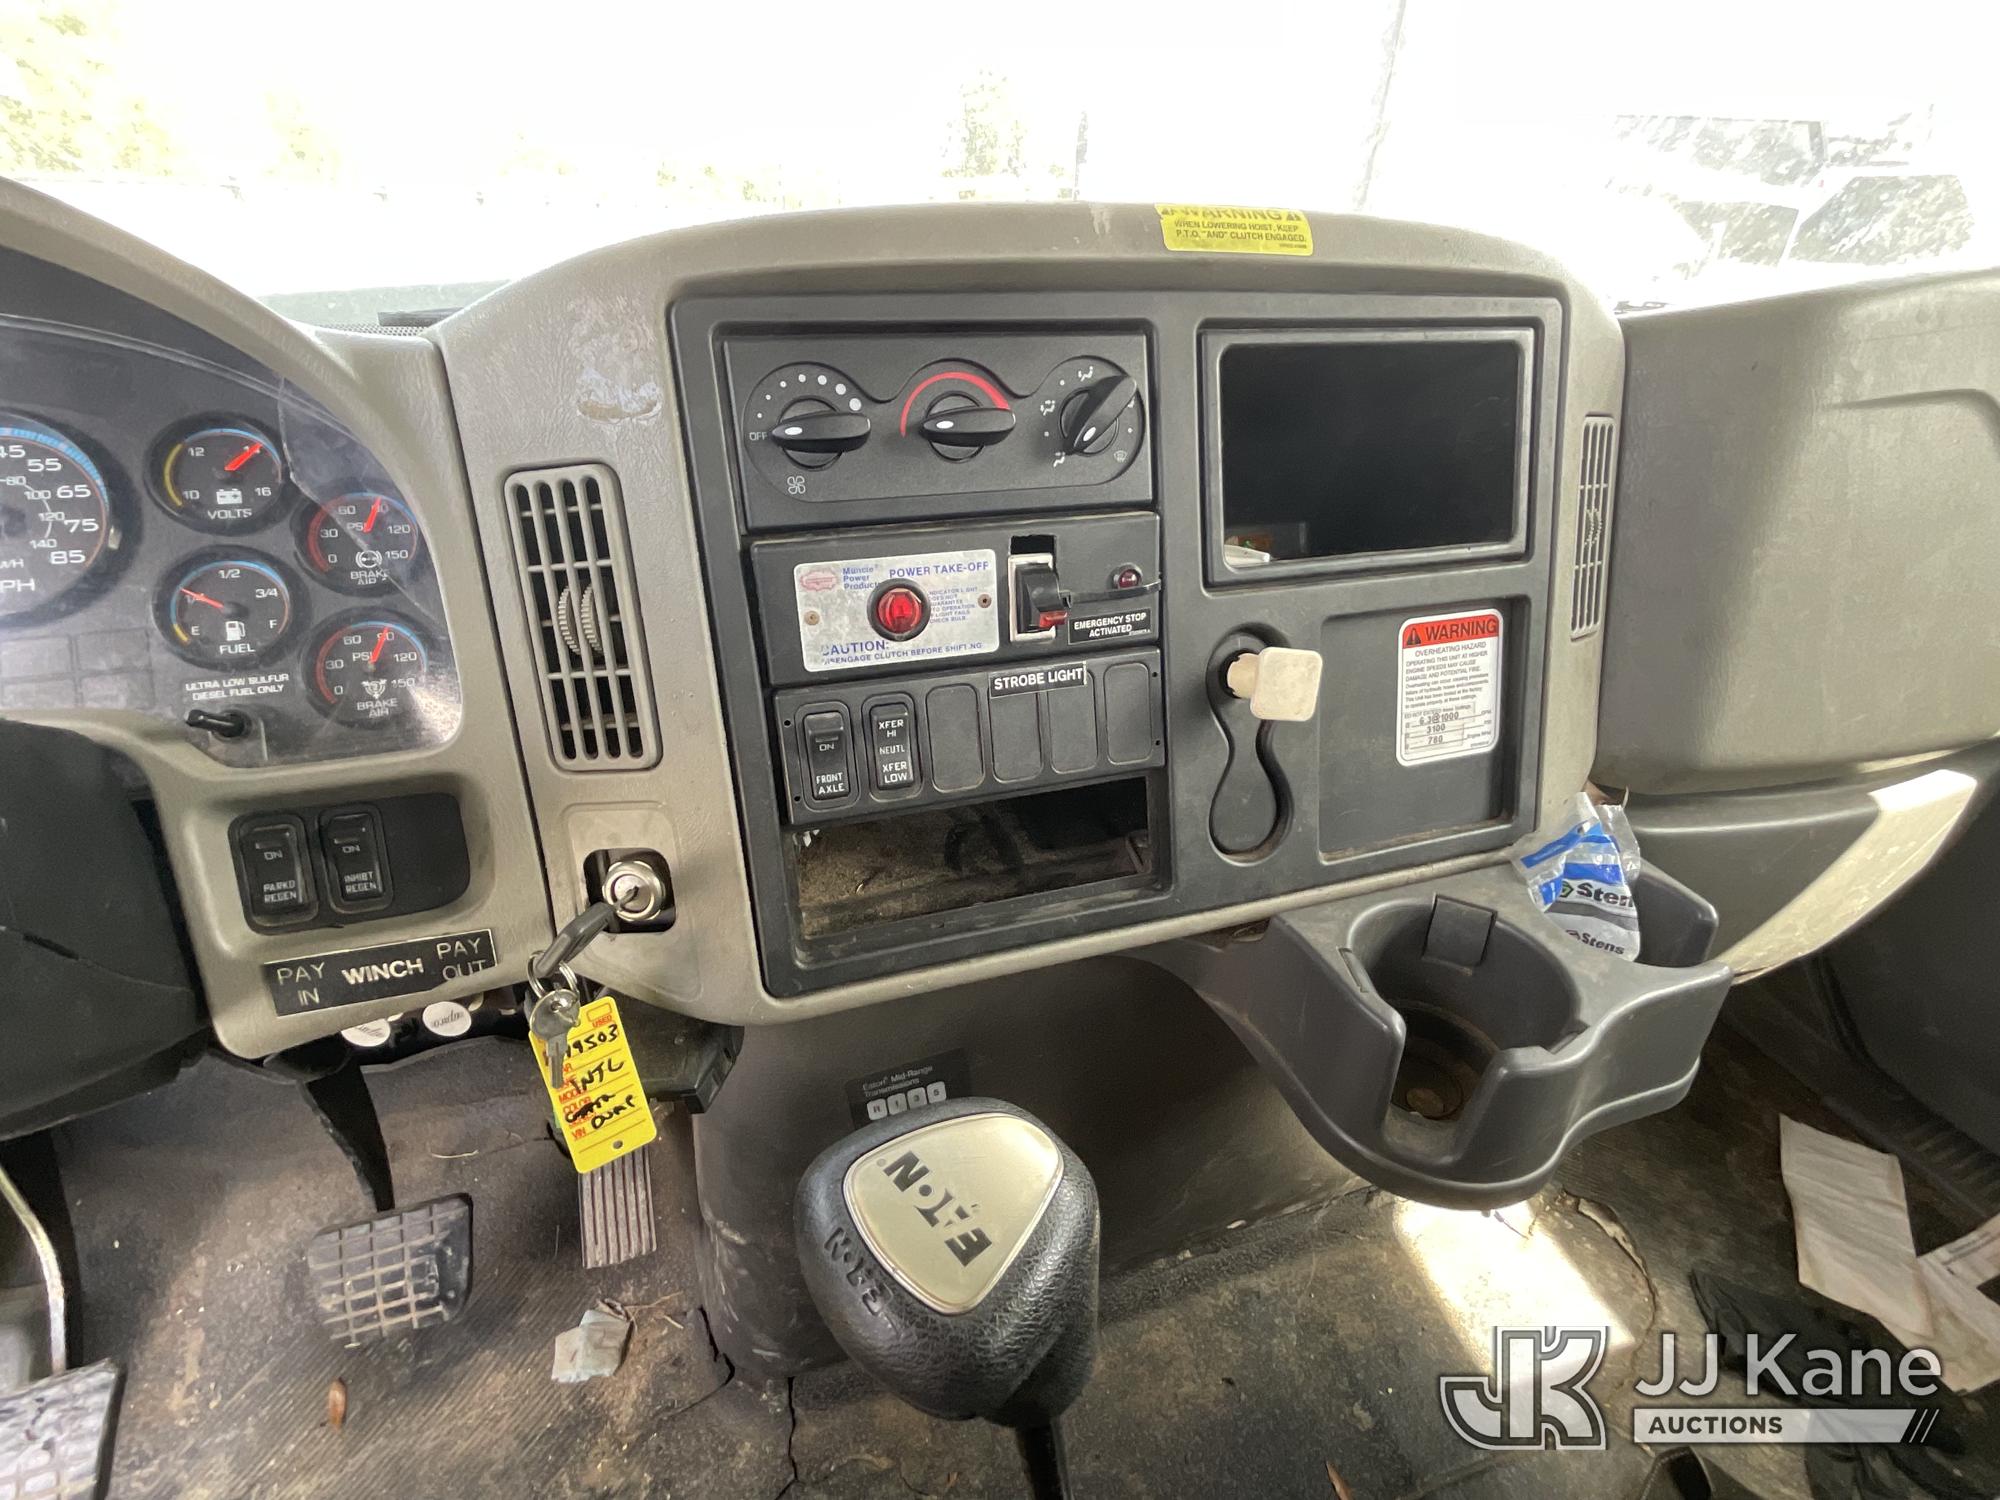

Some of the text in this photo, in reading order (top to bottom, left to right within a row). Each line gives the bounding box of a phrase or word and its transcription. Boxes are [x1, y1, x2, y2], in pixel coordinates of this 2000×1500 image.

[1174, 220, 1200, 228] WHEN
[1202, 222, 1247, 230] LOWERING
[1230, 232, 1264, 241] CLUTCH
[749, 431, 768, 441] OFF
[188, 446, 205, 457] 12
[27, 458, 62, 472] 55
[6, 476, 27, 486] 80
[24, 490, 52, 501] 100
[56, 484, 92, 499] 65
[183, 490, 200, 500] 10
[254, 486, 272, 497] 16
[38, 512, 65, 522] 120
[207, 508, 253, 520] VOLTS
[64, 518, 100, 534] 75
[387, 524, 411, 534] 120
[320, 528, 339, 538] 30
[30, 538, 58, 550] 140
[50, 550, 86, 565] 85
[328, 554, 338, 564] 0
[384, 550, 409, 560] 150
[218, 568, 241, 580] 1/2
[842, 566, 874, 575] Muncie
[889, 561, 989, 579] POWER TAKE-OFF
[843, 574, 870, 582] Power
[0, 578, 36, 592] PH
[255, 588, 279, 599] 3/4
[929, 588, 960, 596] NDICATOR
[269, 619, 278, 630] F
[1074, 612, 1147, 630] EMERGENCY STOP
[191, 626, 200, 636] E
[1088, 624, 1133, 638] ACTIVATED
[1425, 618, 1497, 641] WARNING
[343, 635, 362, 646] 60
[219, 643, 256, 655] FUEL
[874, 650, 909, 660] CLUTCH
[910, 646, 943, 656] BEFORE
[945, 642, 983, 653] SHIFTNG
[1414, 641, 1487, 658] OVERHEATING HAZARD
[394, 651, 418, 663] 120
[1406, 657, 1436, 667] OPERATING
[326, 658, 345, 670] 30
[185, 673, 290, 692] ULTRA LOW SULFUR
[391, 678, 416, 689] 150
[994, 668, 1083, 690] STROBE LIGHT
[192, 684, 285, 701] DIESEL FUEL ONLY
[334, 685, 344, 696] 0
[356, 698, 398, 711] BRAKE
[878, 718, 904, 730] XFER
[1426, 723, 1446, 734] 3100
[886, 730, 896, 738] HI
[819, 743, 835, 752] ON
[879, 744, 906, 755] NEUTL
[882, 760, 908, 773] XFER
[816, 772, 844, 784] FRONT
[884, 772, 908, 784] LOW
[818, 782, 845, 795] AXLE
[264, 850, 284, 860] ON
[342, 844, 361, 854] ON
[344, 871, 374, 883] INHIBT
[263, 880, 296, 892] PARKD
[345, 882, 377, 894] REGEN
[264, 890, 297, 904] REGEN
[1576, 882, 1633, 908] Sten
[436, 937, 482, 960] PAY
[1580, 932, 1625, 956] Stens
[276, 962, 326, 986] PAY
[341, 958, 424, 986] WINCH
[442, 959, 488, 982] OUT
[298, 986, 321, 1007] IN
[592, 1014, 613, 1028] USED
[882, 1150, 993, 1268] EATON
